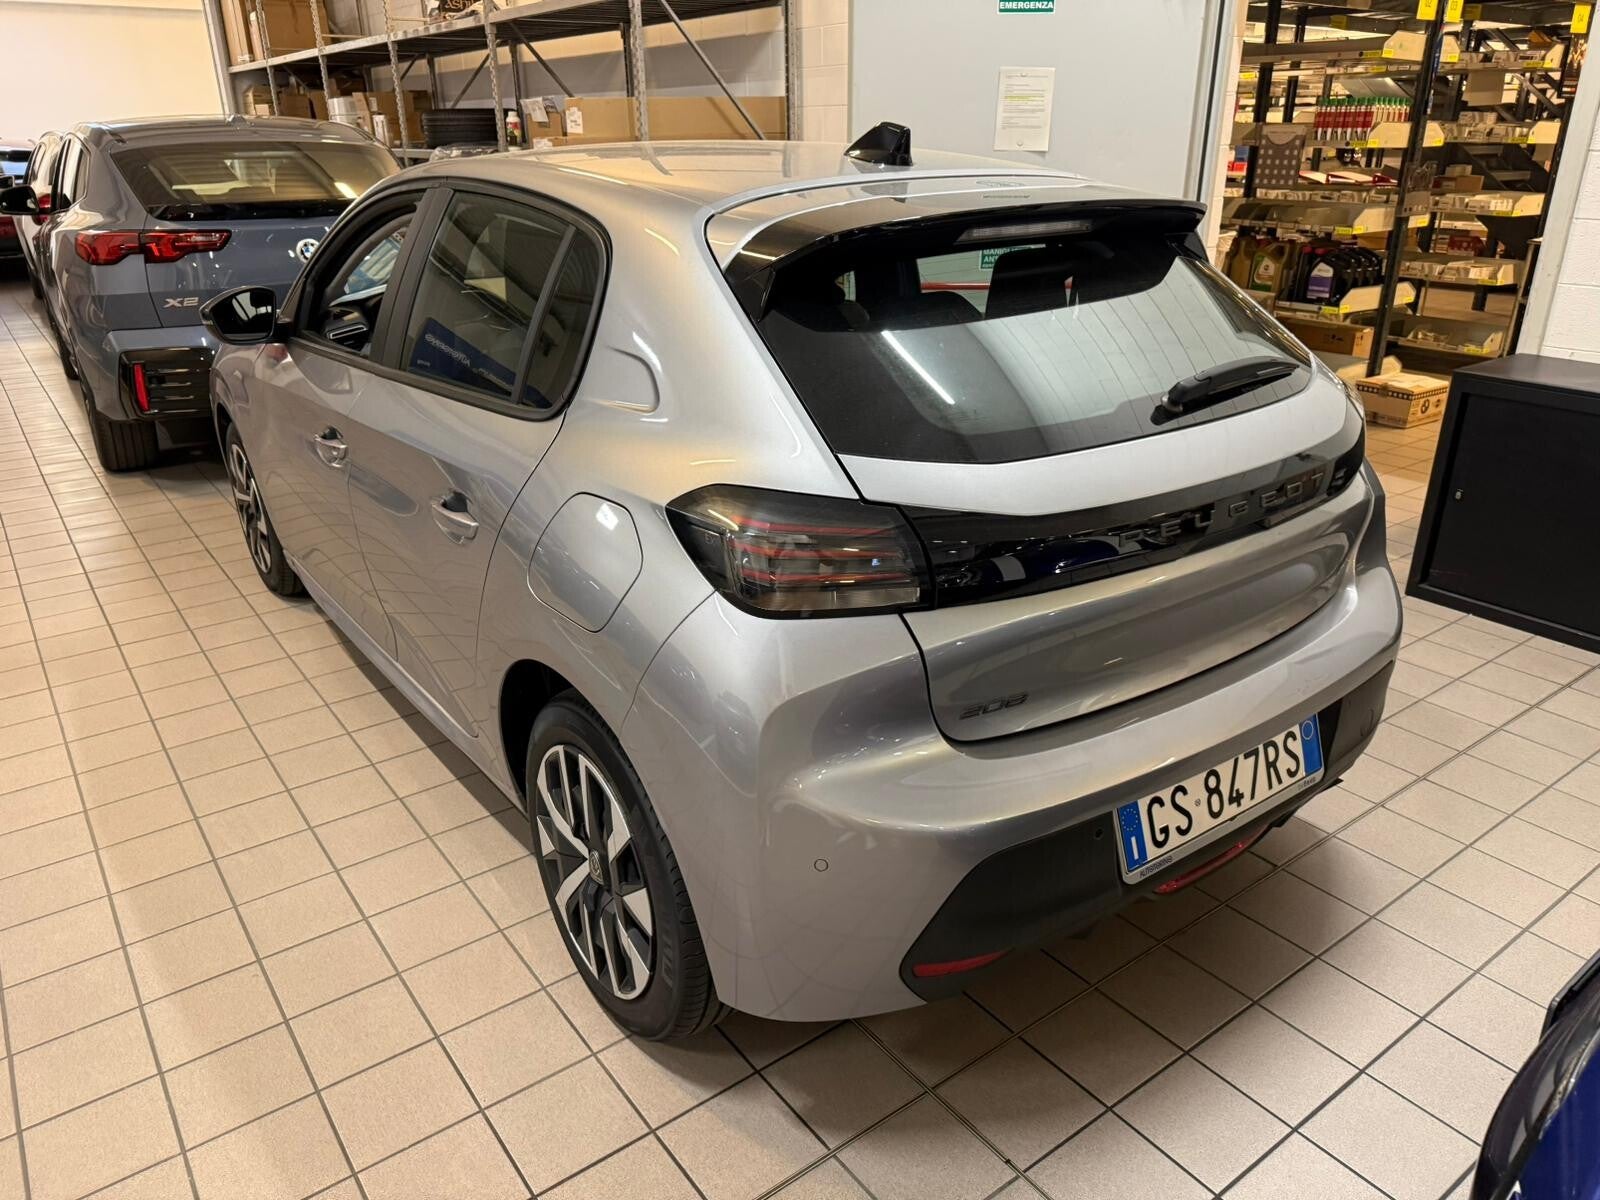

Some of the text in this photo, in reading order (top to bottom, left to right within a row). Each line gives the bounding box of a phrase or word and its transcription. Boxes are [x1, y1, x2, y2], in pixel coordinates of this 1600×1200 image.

[999, 1, 1054, 9] EMERGENZA
[163, 297, 199, 308] X2
[1119, 471, 1324, 548] PEUGEOT
[1147, 730, 1300, 849] GS 847RS
